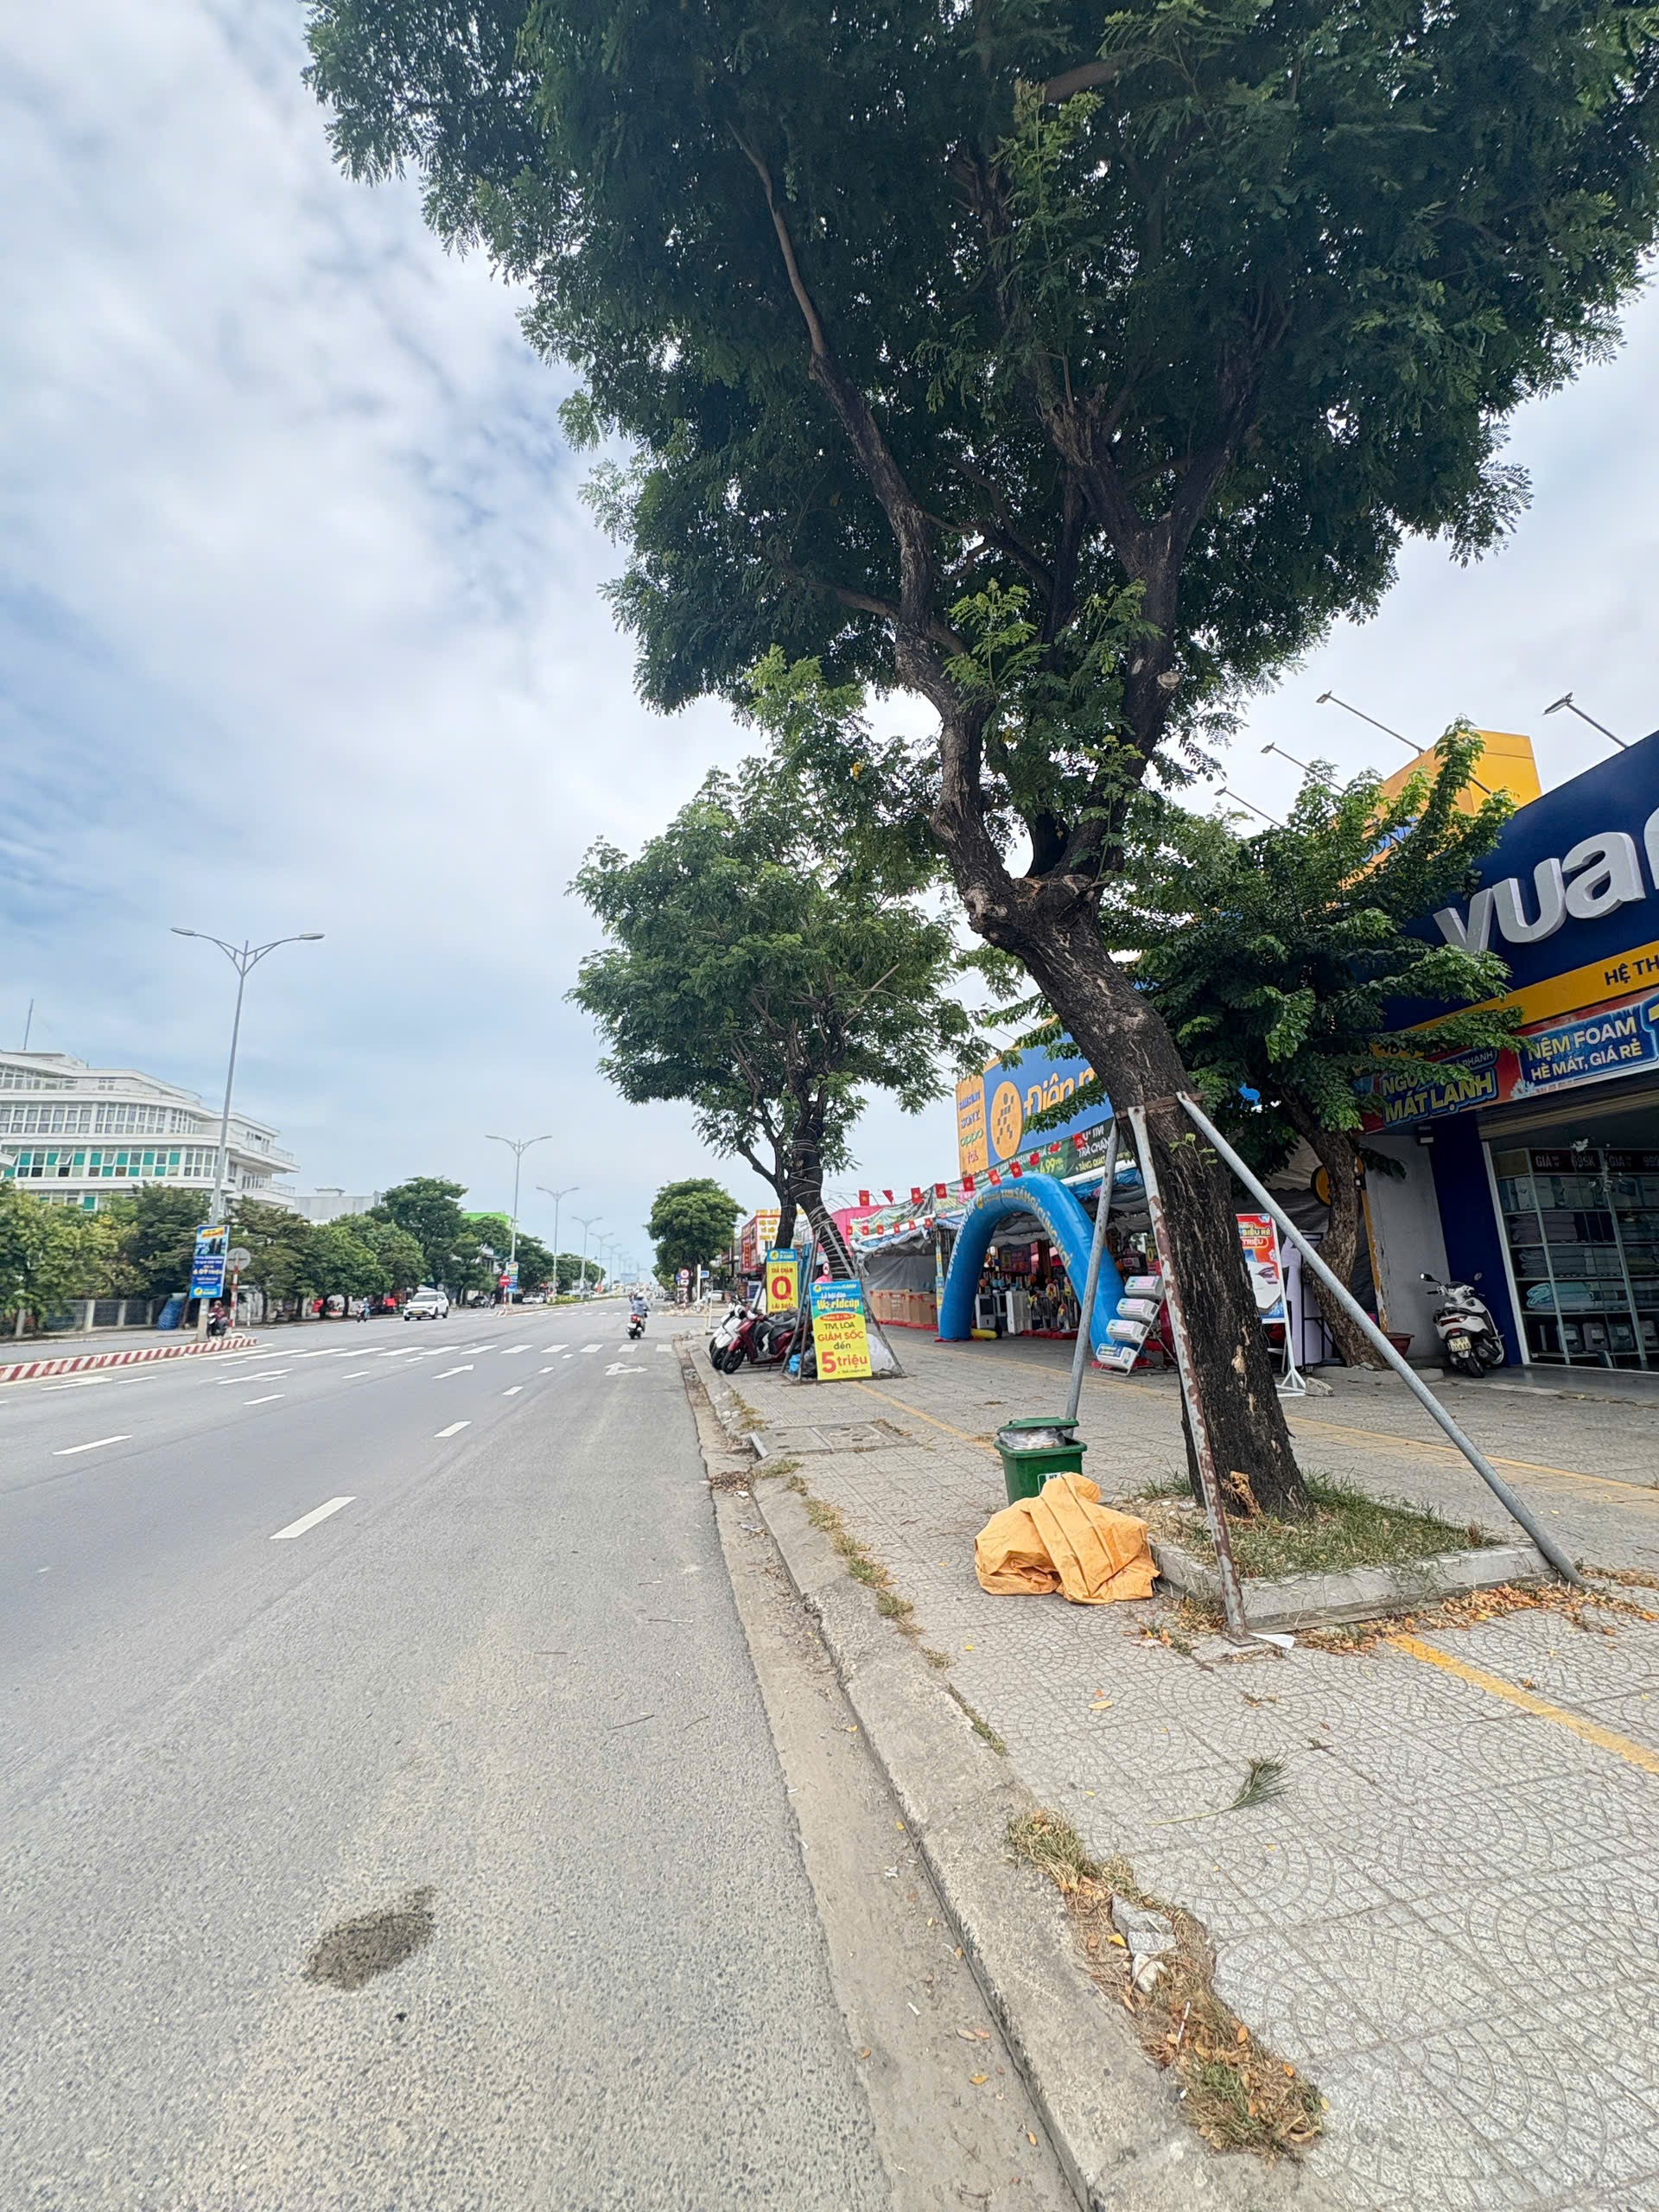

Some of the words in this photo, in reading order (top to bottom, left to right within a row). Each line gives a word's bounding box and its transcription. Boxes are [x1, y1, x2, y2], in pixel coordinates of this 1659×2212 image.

[1433, 808, 1659, 953] vua
[1604, 963, 1630, 986] HỆ
[1528, 1035, 1571, 1061] NỆM
[1573, 1016, 1637, 1049] FOAM
[1531, 1063, 1551, 1081] HÈ
[1553, 1055, 1588, 1077] MÁT,
[1590, 1045, 1618, 1066] GIÁ
[1619, 1039, 1643, 1059] RẺ
[1385, 1090, 1427, 1122] MÁT
[1430, 1071, 1493, 1111] LẠNH
[1535, 1153, 1552, 1167] GIÁ
[1243, 1237, 1263, 1246] TRIỆU
[817, 1332, 842, 1342] GIẢM
[844, 1329, 864, 1339] SỐC
[822, 1351, 836, 1373] 5
[837, 1354, 868, 1368] triệu
